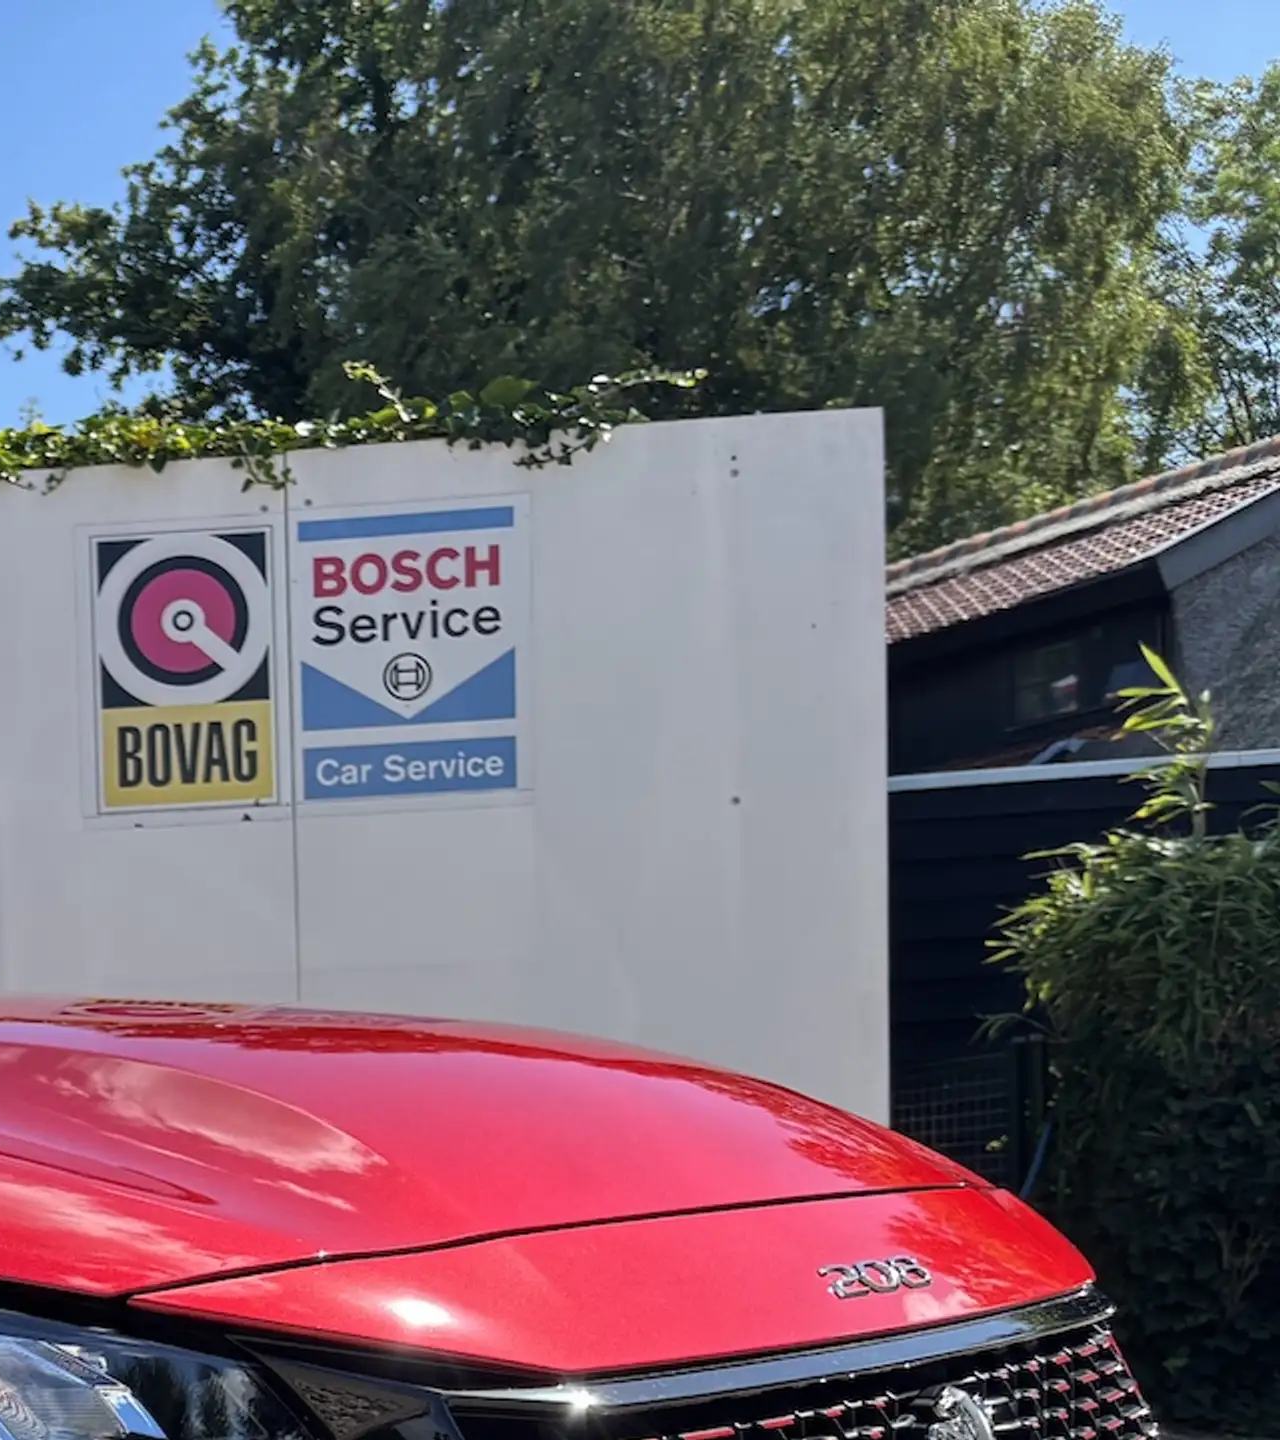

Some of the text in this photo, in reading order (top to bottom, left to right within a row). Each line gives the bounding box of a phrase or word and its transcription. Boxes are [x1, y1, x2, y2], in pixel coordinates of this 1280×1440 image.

[313, 544, 501, 598] BOSCH
[311, 599, 502, 647] Service
[117, 718, 259, 788] BOVAG
[315, 751, 505, 787] Car Service
[817, 1255, 932, 1300] 208
